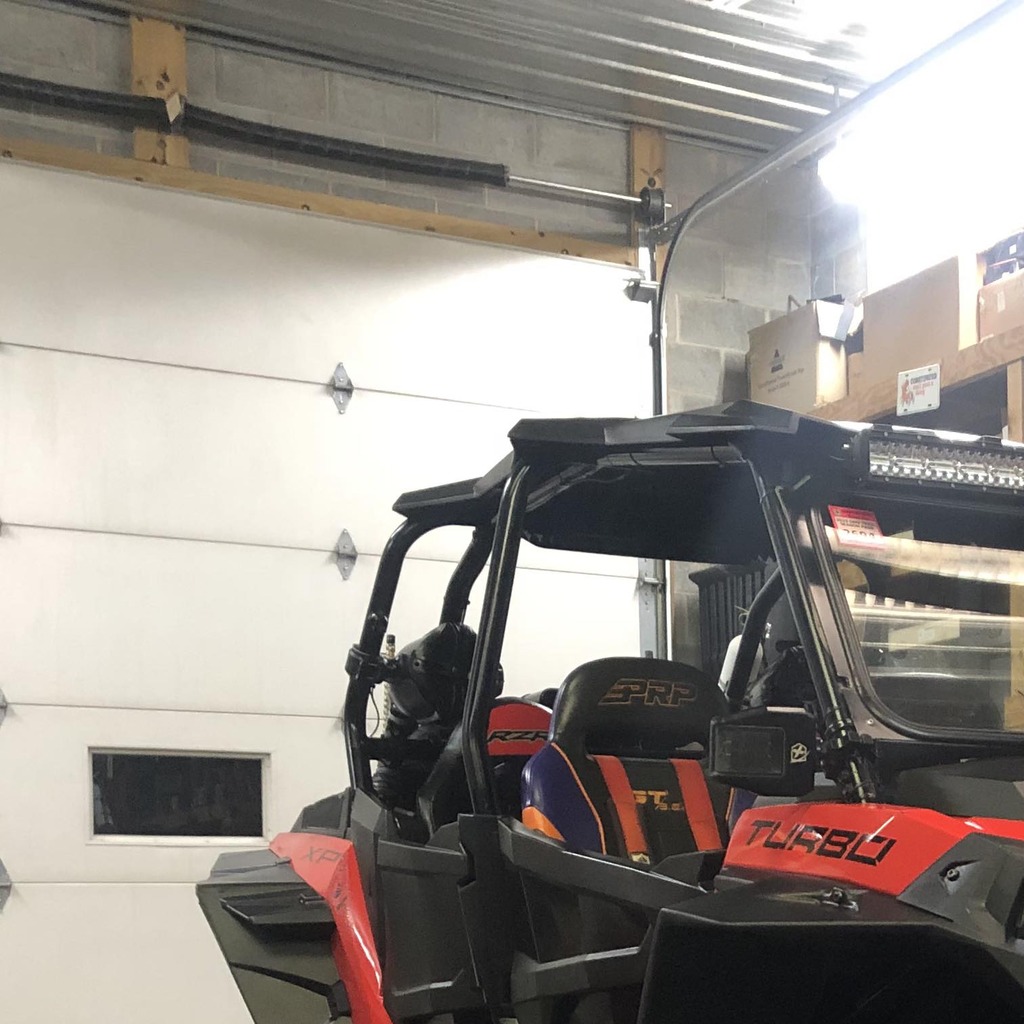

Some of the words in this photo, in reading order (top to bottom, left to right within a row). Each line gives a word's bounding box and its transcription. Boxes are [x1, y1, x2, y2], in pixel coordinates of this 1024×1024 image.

[598, 678, 698, 706] PRP
[300, 846, 341, 864] XP
[746, 819, 898, 867] TURBO
